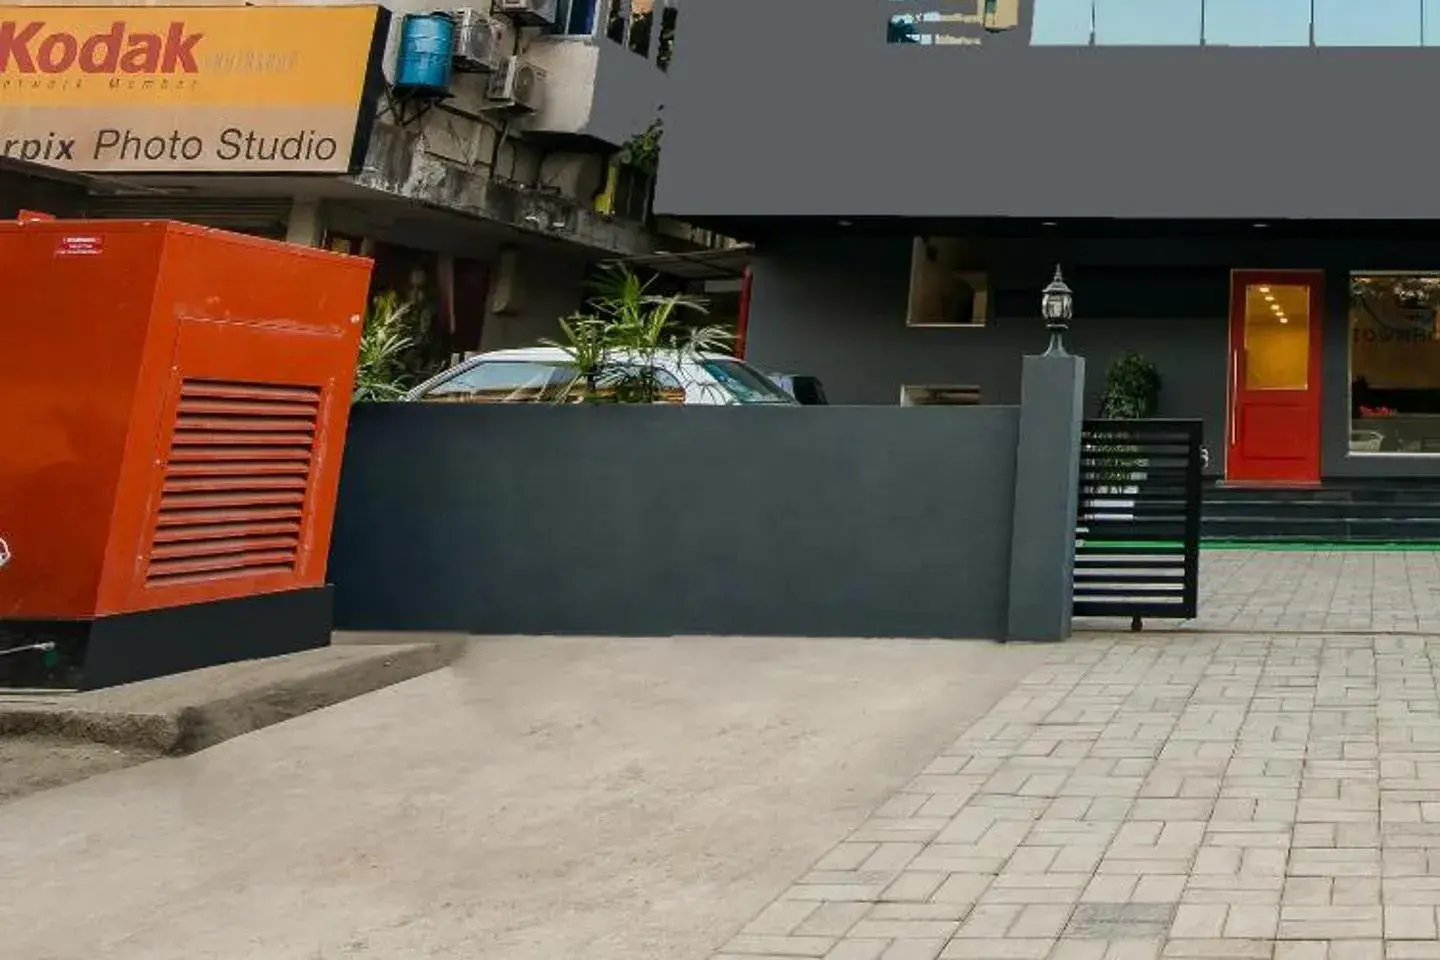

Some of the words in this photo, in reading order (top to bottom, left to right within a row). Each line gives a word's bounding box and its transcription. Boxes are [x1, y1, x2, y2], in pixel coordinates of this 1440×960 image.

[0, 21, 205, 74] Kodak
[93, 129, 203, 161] Photo
[215, 127, 338, 161] Studio
